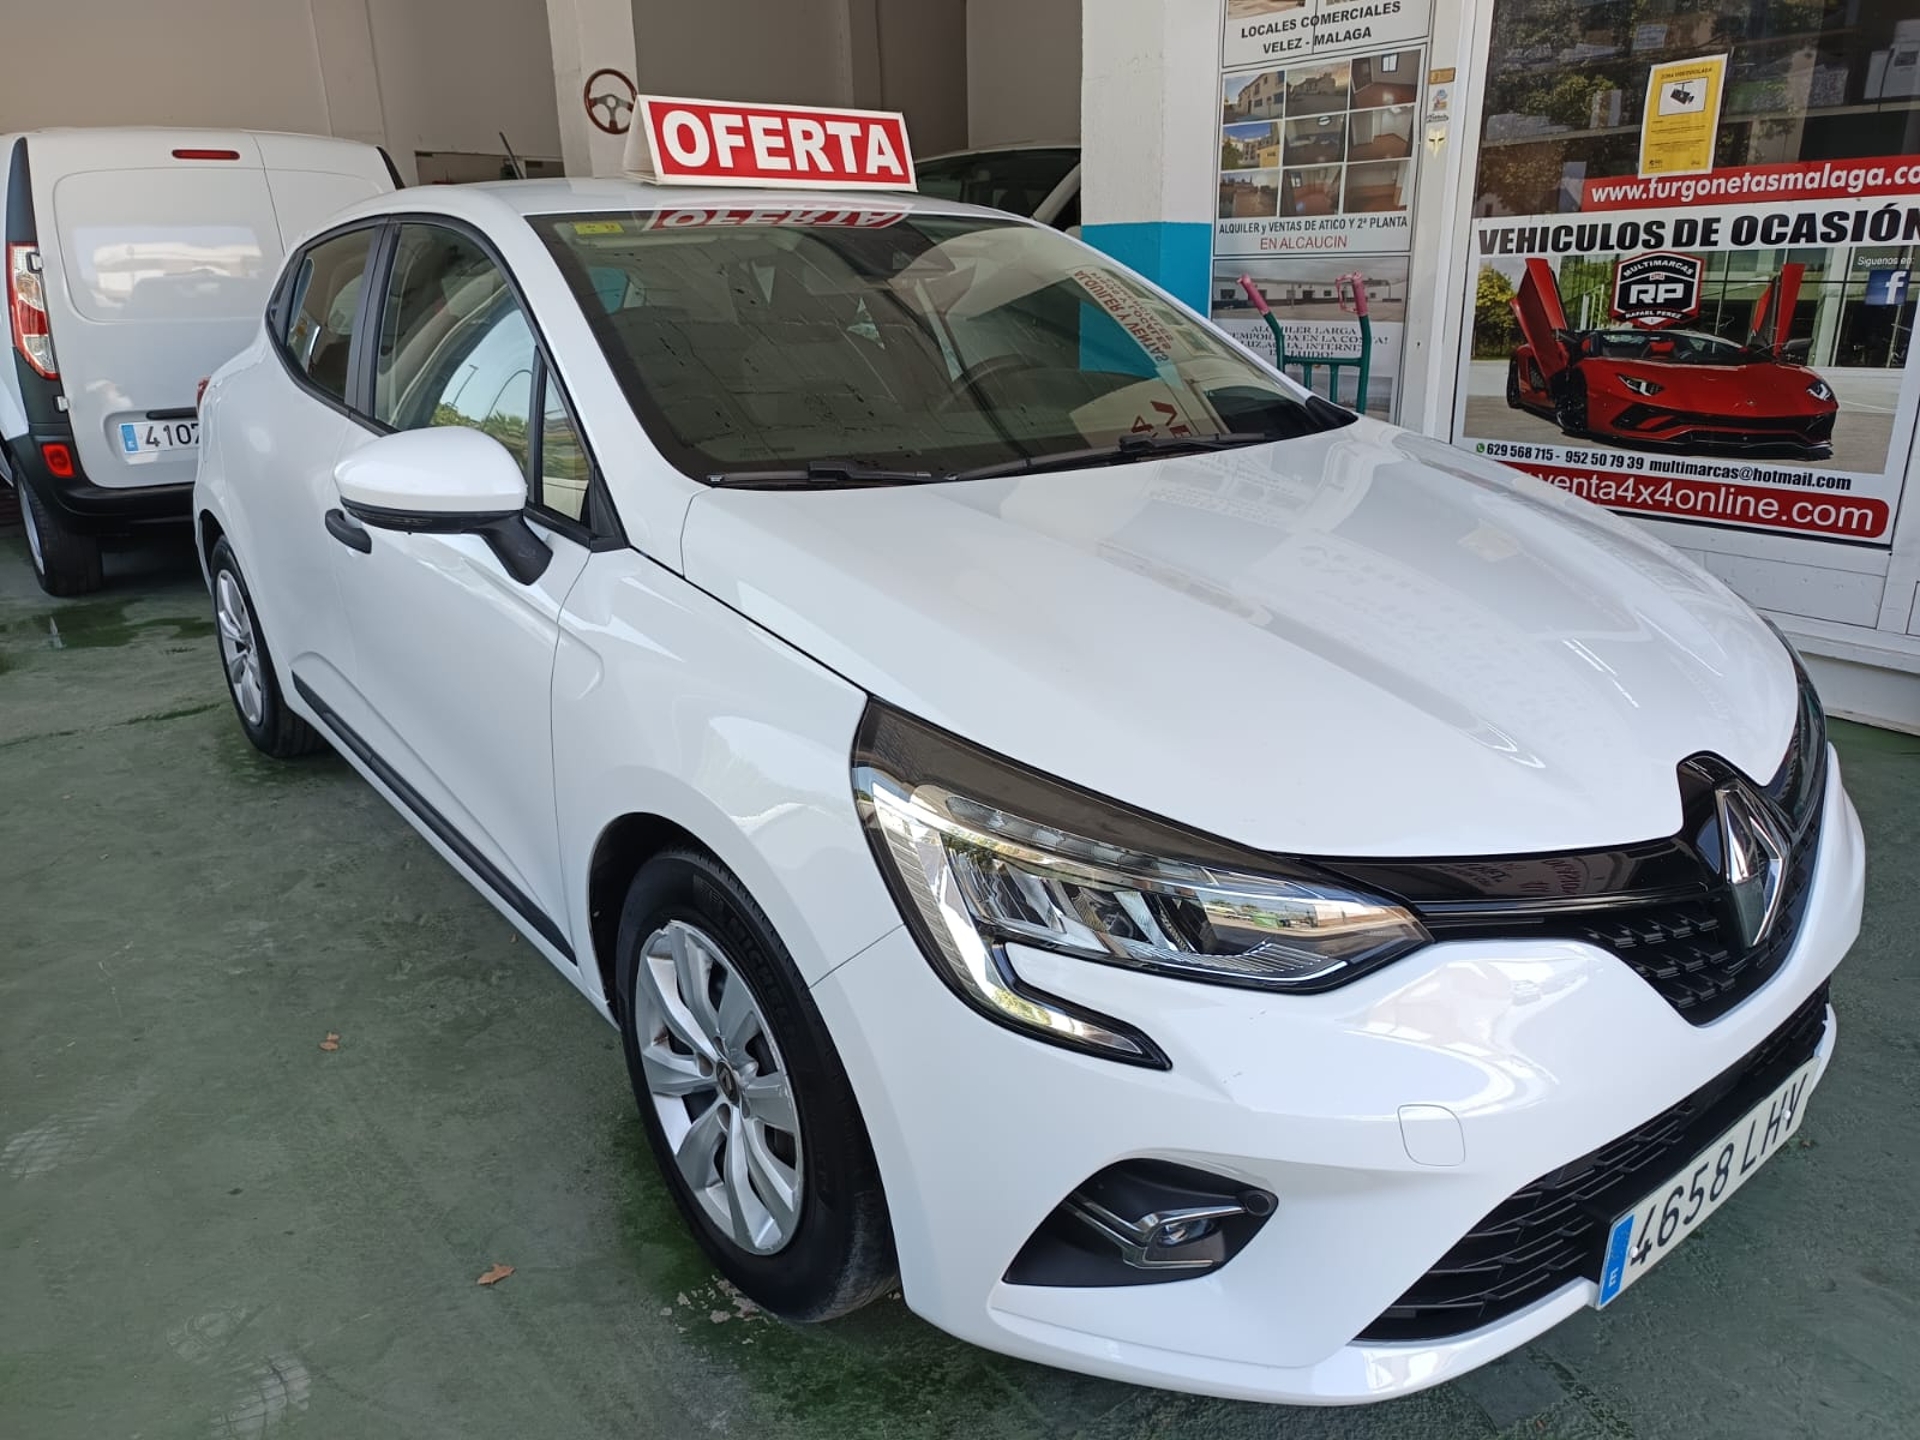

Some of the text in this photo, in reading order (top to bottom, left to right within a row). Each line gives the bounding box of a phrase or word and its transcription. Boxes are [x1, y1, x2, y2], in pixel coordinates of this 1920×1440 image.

[1240, 0, 1401, 39] LOCALES COMERCIALES
[1263, 37, 1302, 54] VELEZ
[1314, 26, 1372, 46] MALAGA
[661, 110, 905, 176] OFERTA
[1219, 223, 1260, 235] ALQUILER
[1261, 225, 1266, 235] y
[1269, 220, 1302, 233] VENTAS
[1304, 219, 1317, 231] DE
[1319, 218, 1345, 231] ATICO
[1349, 217, 1356, 230] Y
[1370, 216, 1408, 229] PLANTA
[1479, 202, 1920, 255] VEHICULOS DE OCASIÓN
[1260, 235, 1348, 250] EN ALCAUCIN
[1623, 259, 1695, 277] MULTIMARCAS
[1628, 283, 1684, 304] RP
[1625, 310, 1653, 319] RAFAEL
[1302, 334, 1318, 342] EN
[1322, 335, 1337, 343] LA
[1315, 326, 1357, 335] LARGA
[1487, 442, 1507, 456] 629
[1510, 445, 1532, 459] 568
[1535, 447, 1553, 461] 715
[1565, 450, 1587, 464] 952
[1590, 452, 1607, 467] 50
[1610, 454, 1624, 468] 79
[1627, 456, 1644, 470] 39
[1649, 459, 1852, 491] multimarcas@hotmail.com
